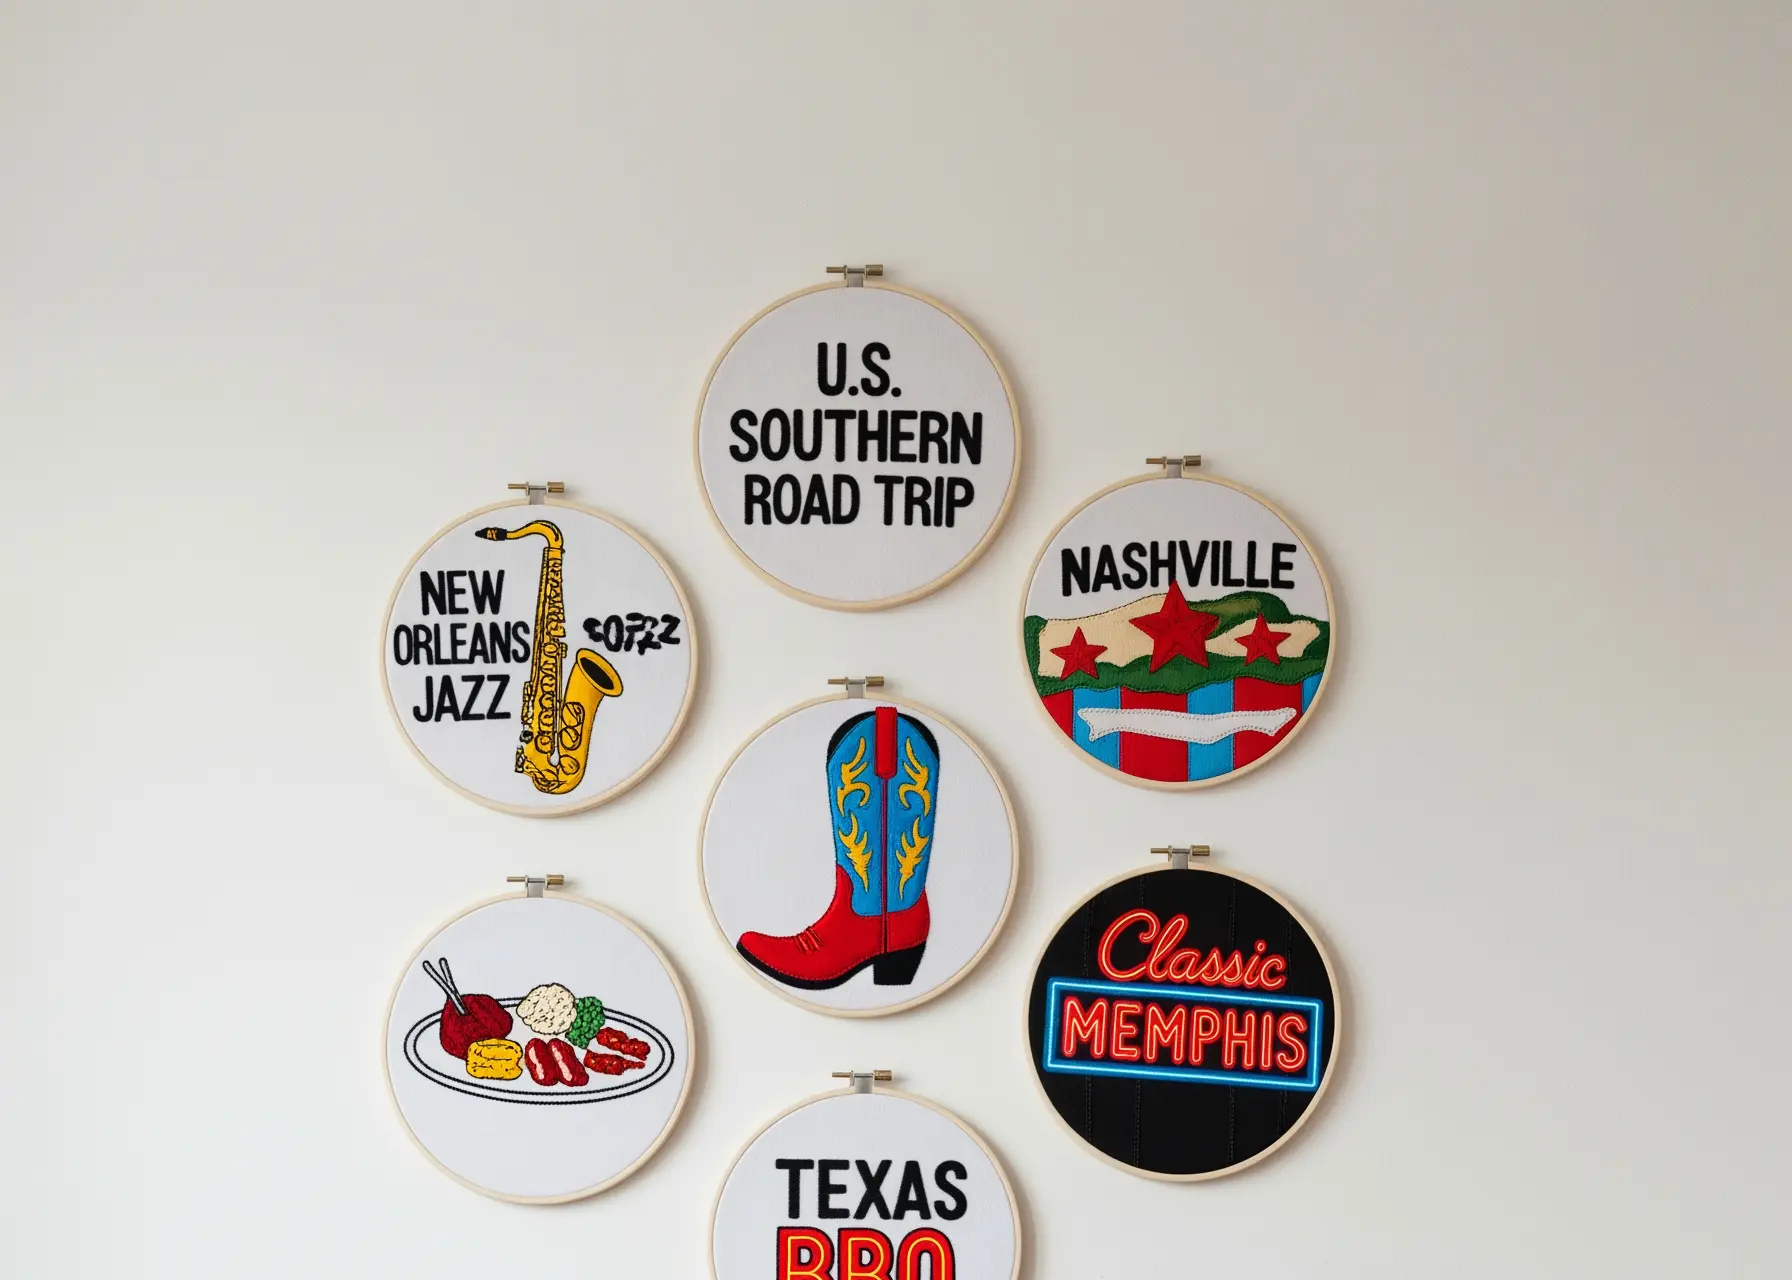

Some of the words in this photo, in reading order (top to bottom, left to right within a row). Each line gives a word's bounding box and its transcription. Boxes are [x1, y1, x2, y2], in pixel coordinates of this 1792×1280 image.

[817, 342, 902, 397] U.S.
[729, 408, 983, 465] SOUTHERN
[744, 474, 860, 525] ROAD
[874, 475, 975, 528] TRIP
[420, 569, 505, 615] NEW
[1060, 540, 1297, 597] NASHVILLE
[393, 622, 530, 666] ORLEANS
[412, 674, 511, 722] JAZZ
[1098, 908, 1287, 990] Classic
[1061, 995, 1307, 1072] MEMPHIS
[775, 1158, 968, 1221] TEXAS
